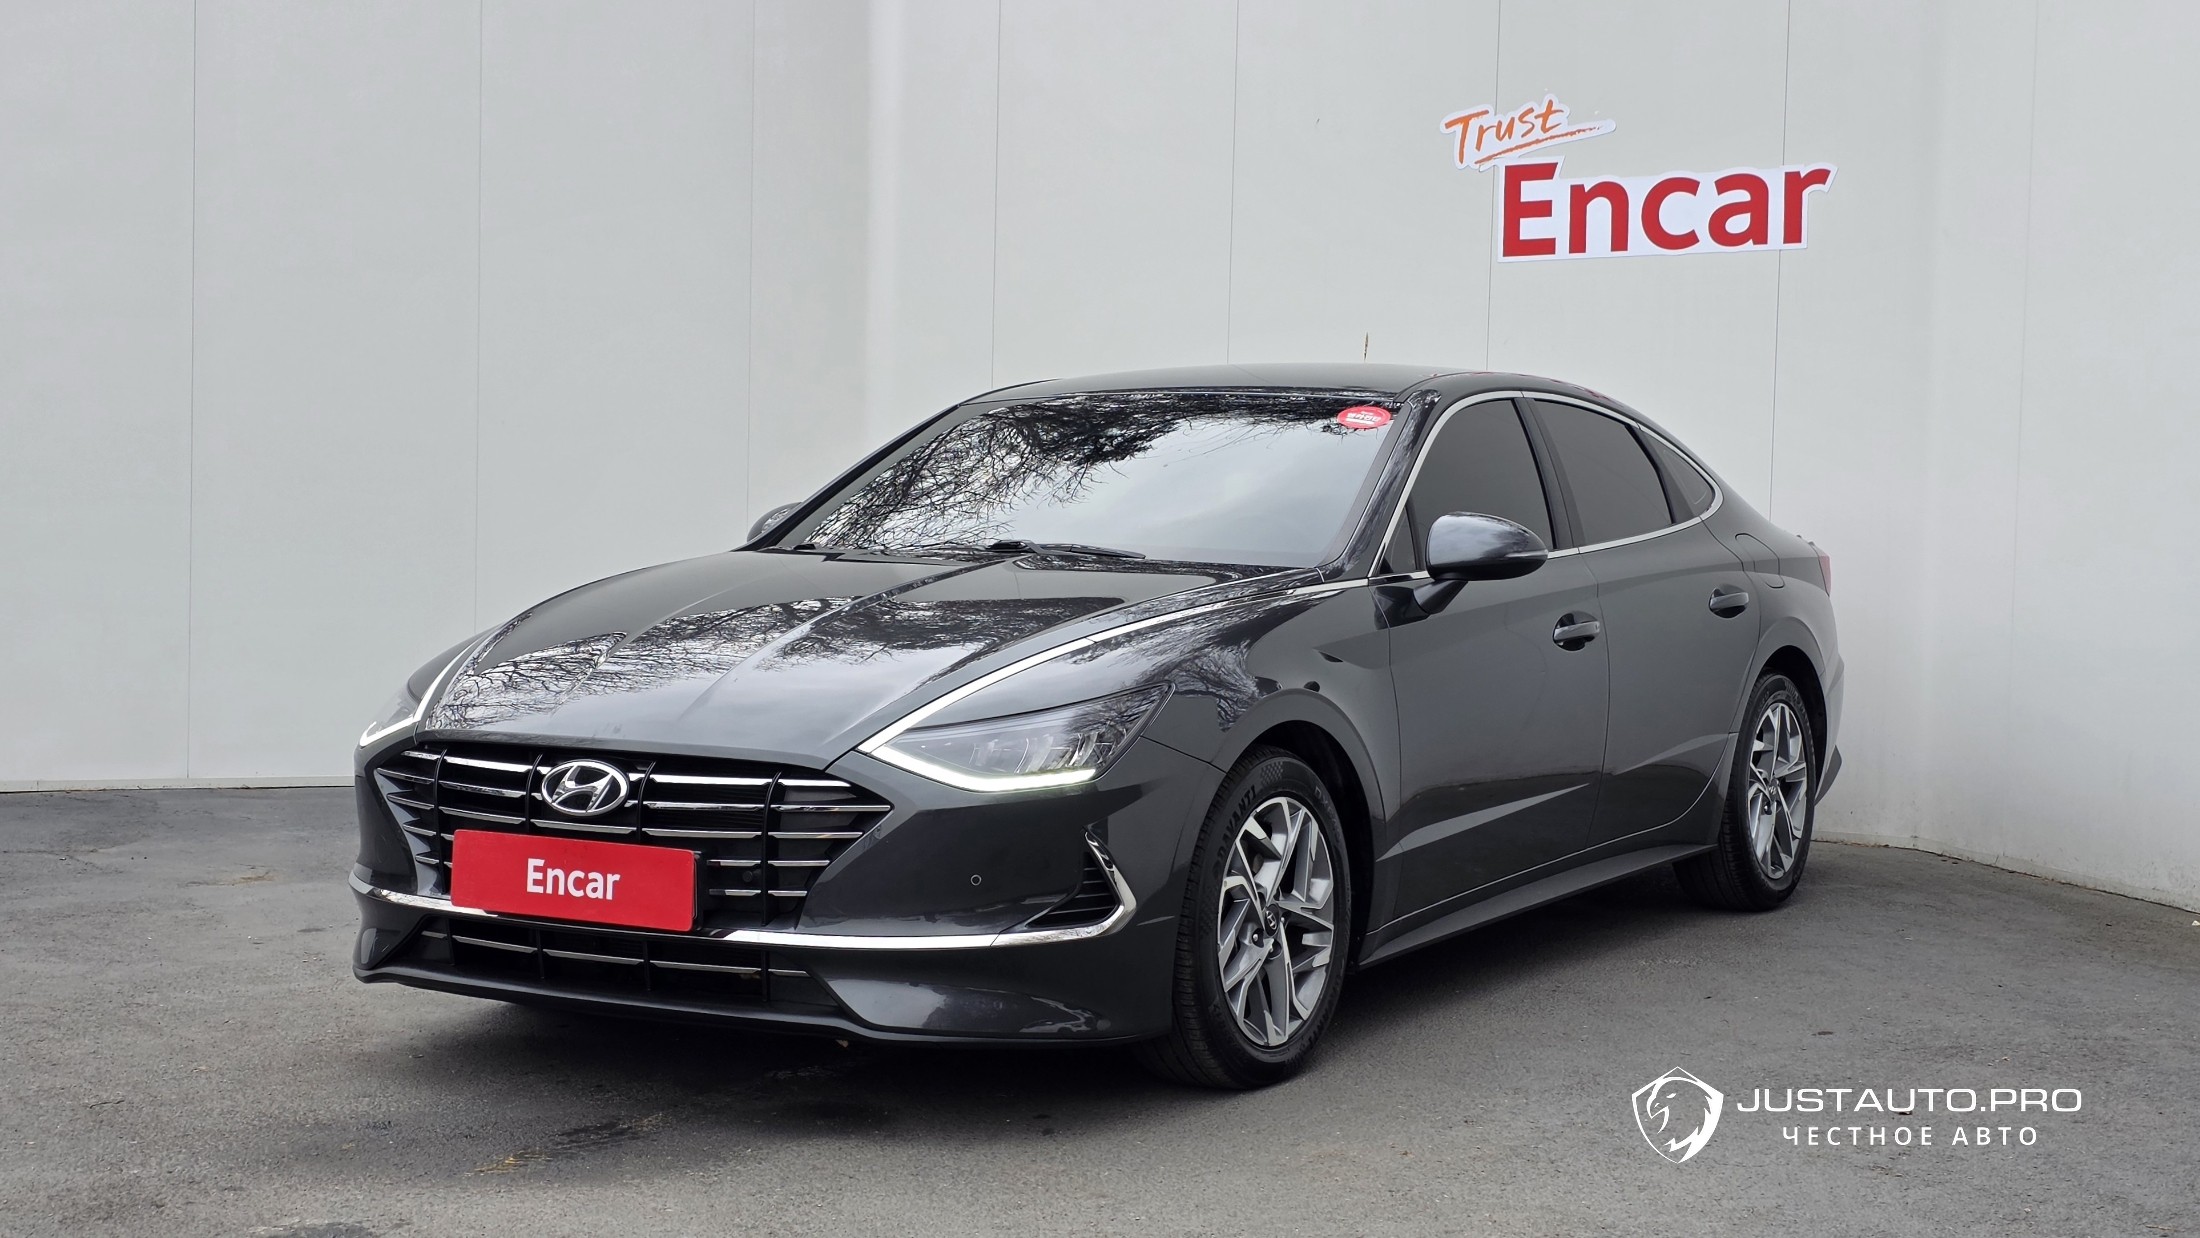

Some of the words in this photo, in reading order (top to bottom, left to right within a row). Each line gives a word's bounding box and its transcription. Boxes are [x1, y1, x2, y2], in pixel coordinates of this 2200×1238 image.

[1445, 98, 1564, 164] Trust
[1502, 162, 1832, 257] Encar
[526, 857, 621, 901] Encar
